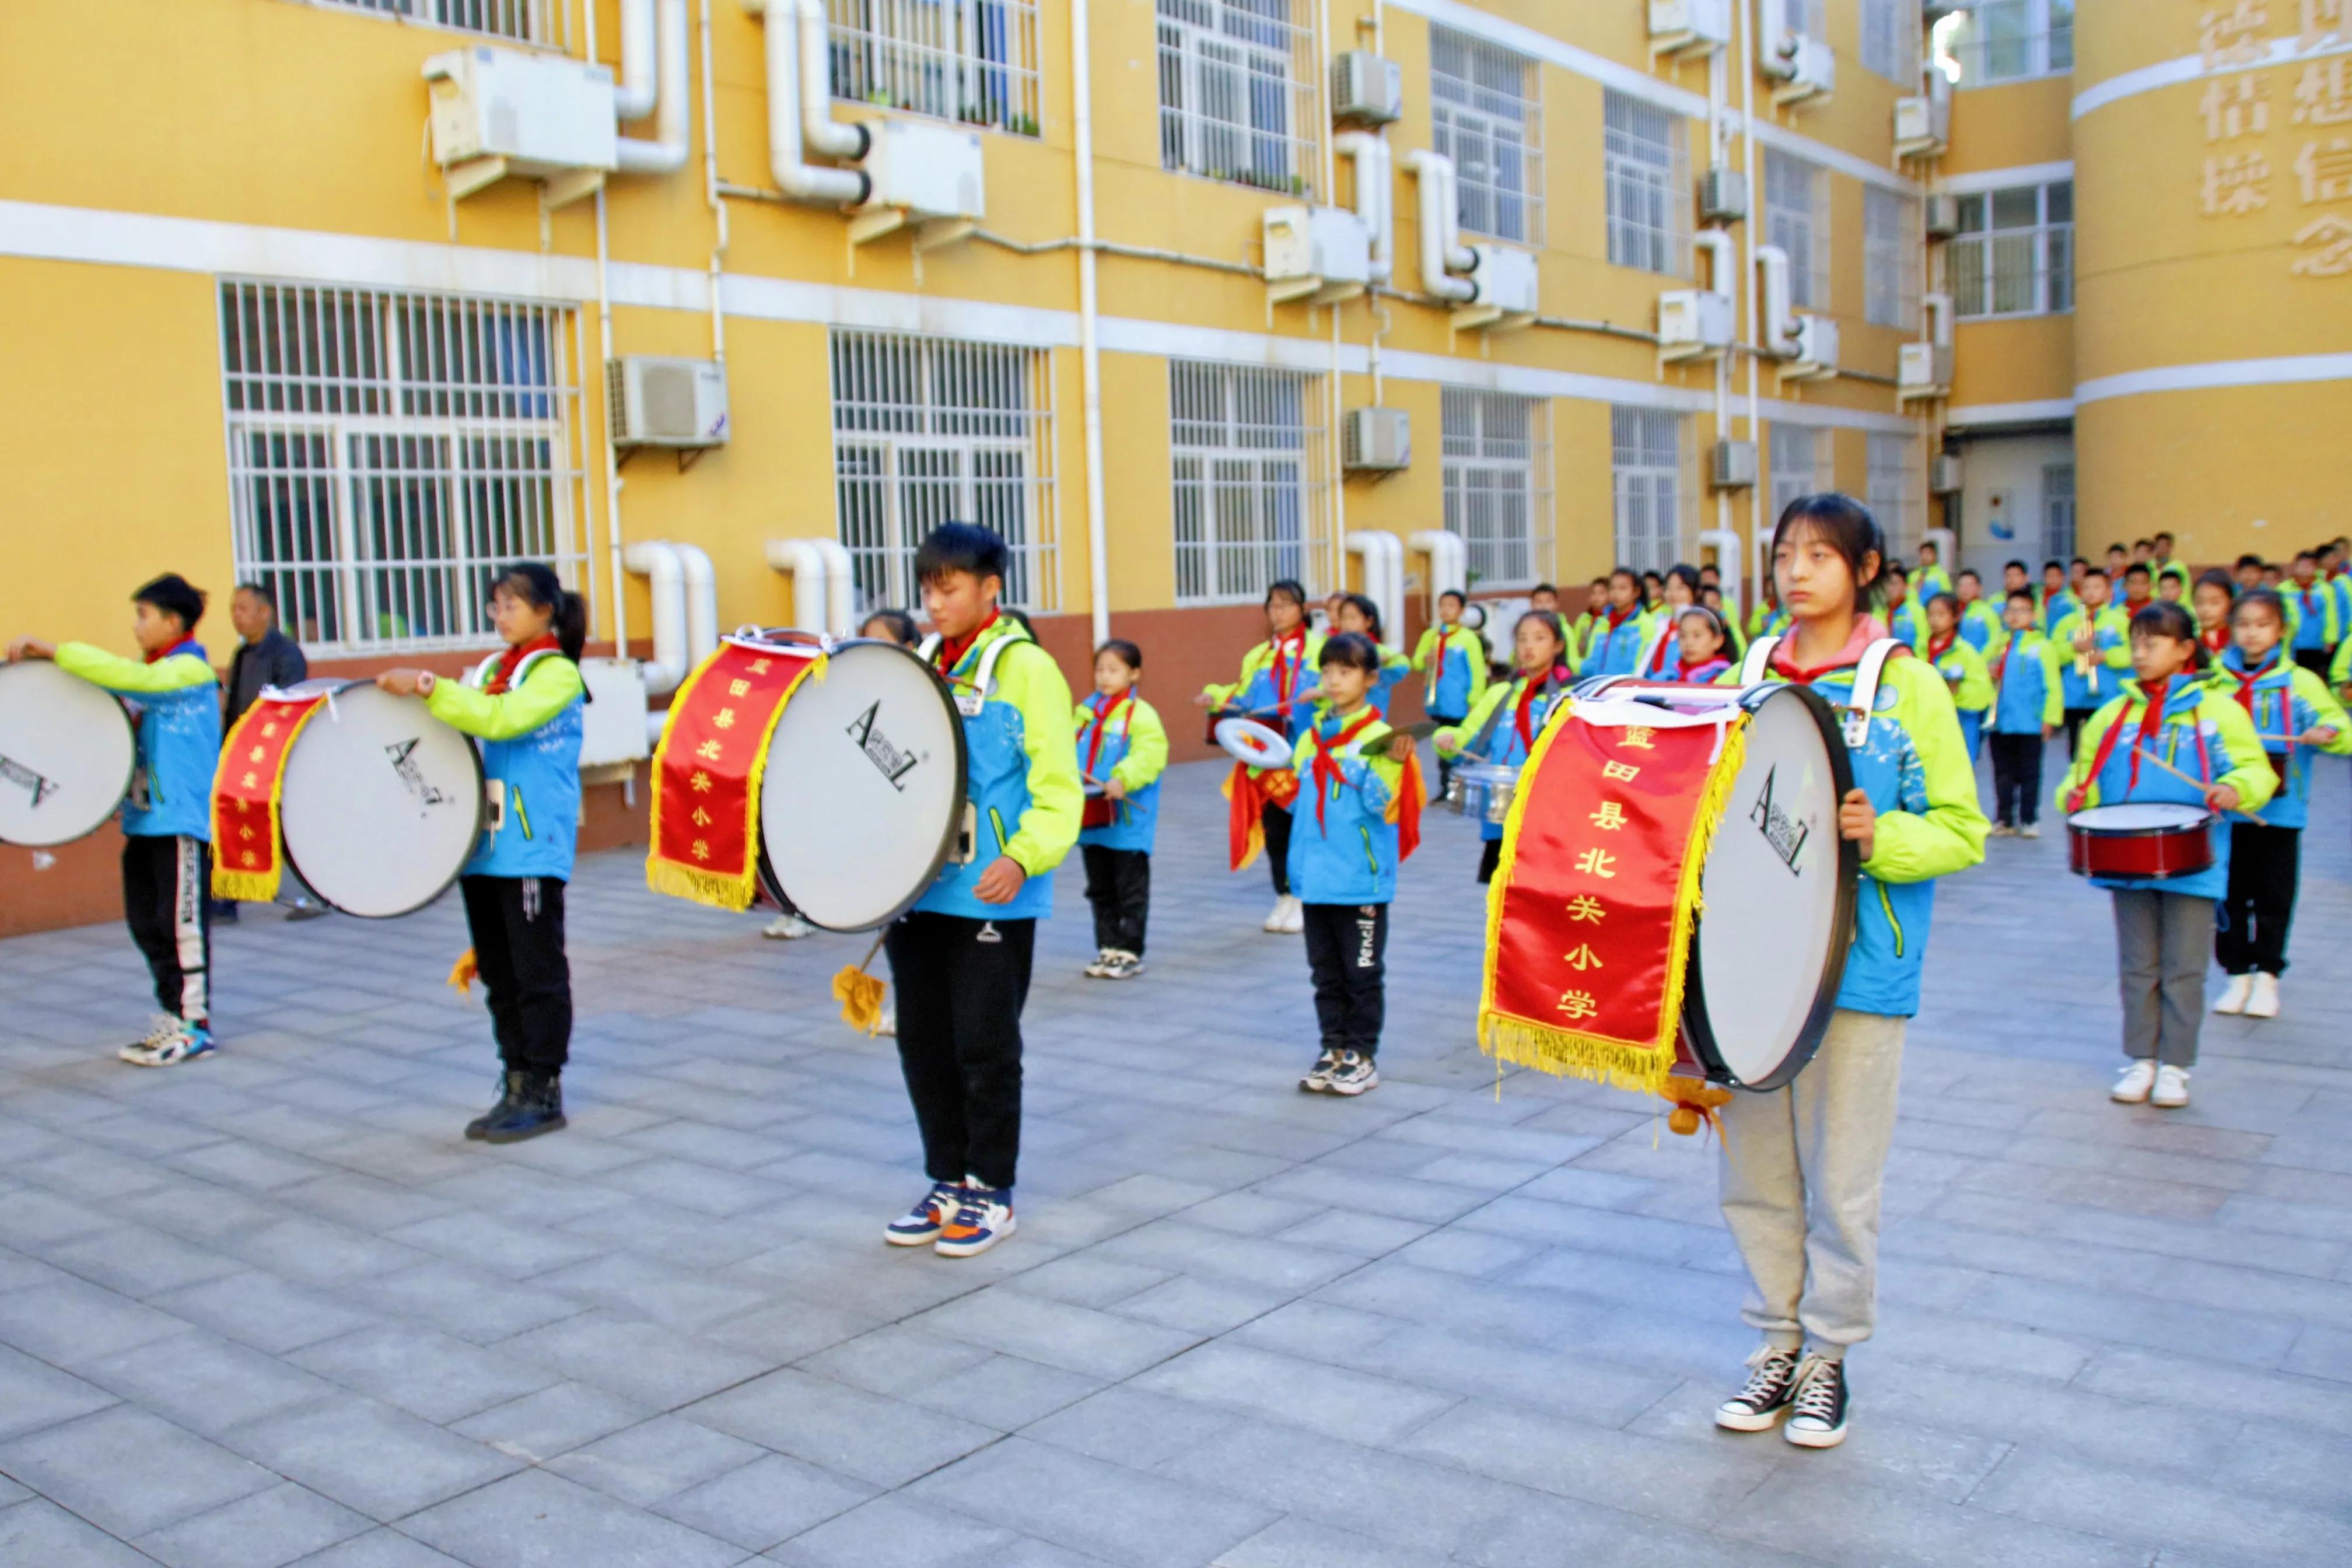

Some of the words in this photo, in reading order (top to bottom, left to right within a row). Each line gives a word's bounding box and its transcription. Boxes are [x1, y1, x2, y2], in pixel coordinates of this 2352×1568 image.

[1556, 724, 1657, 1020] 蓝田县北关小学
